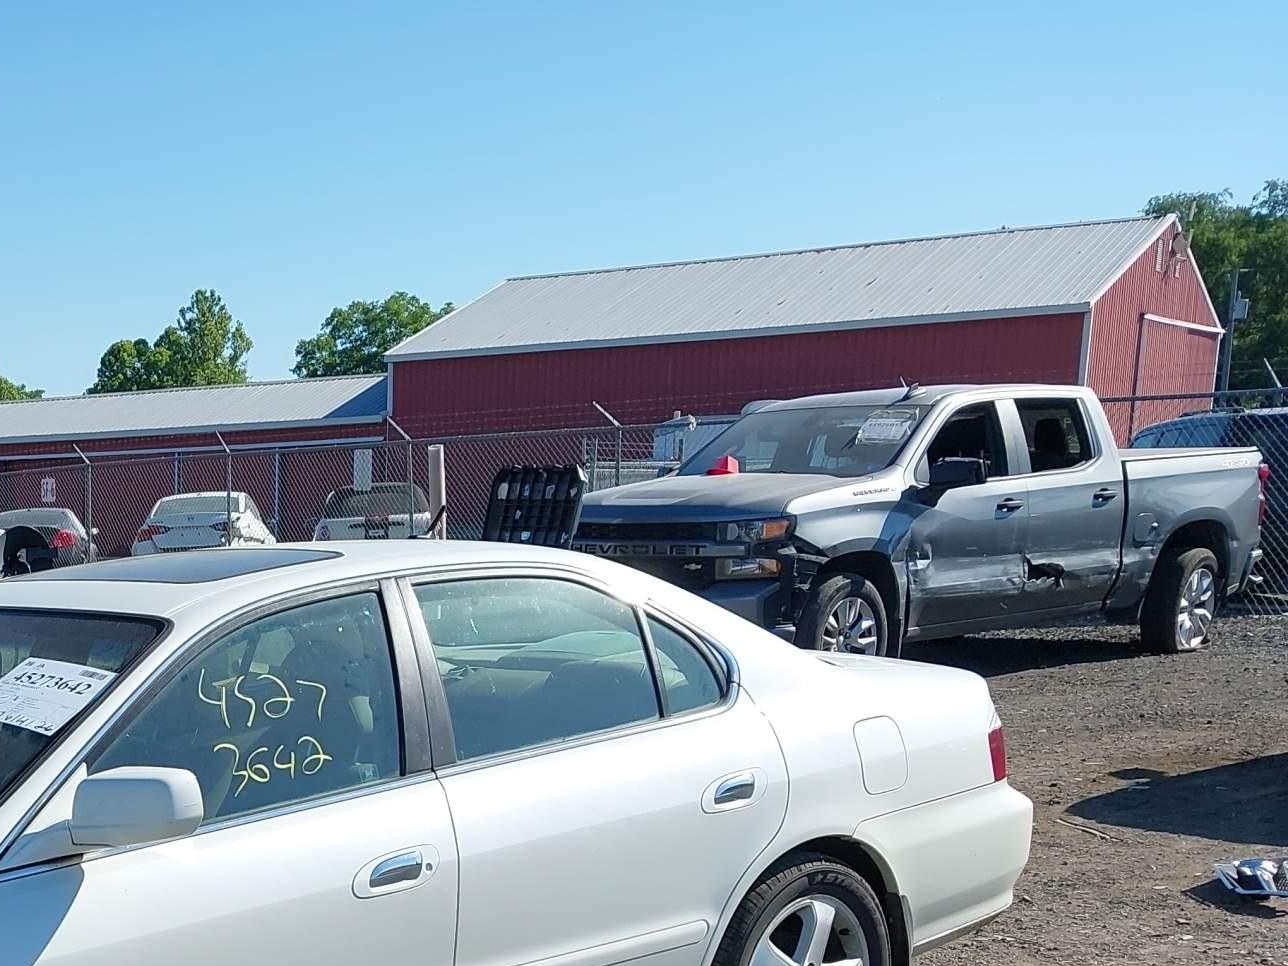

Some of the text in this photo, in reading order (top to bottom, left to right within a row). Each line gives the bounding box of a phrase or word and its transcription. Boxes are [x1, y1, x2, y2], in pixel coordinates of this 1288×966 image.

[571, 543, 707, 556] HEVROLET
[13, 671, 93, 695] 45273642
[198, 668, 327, 728] 4527
[214, 735, 333, 798] 3642
